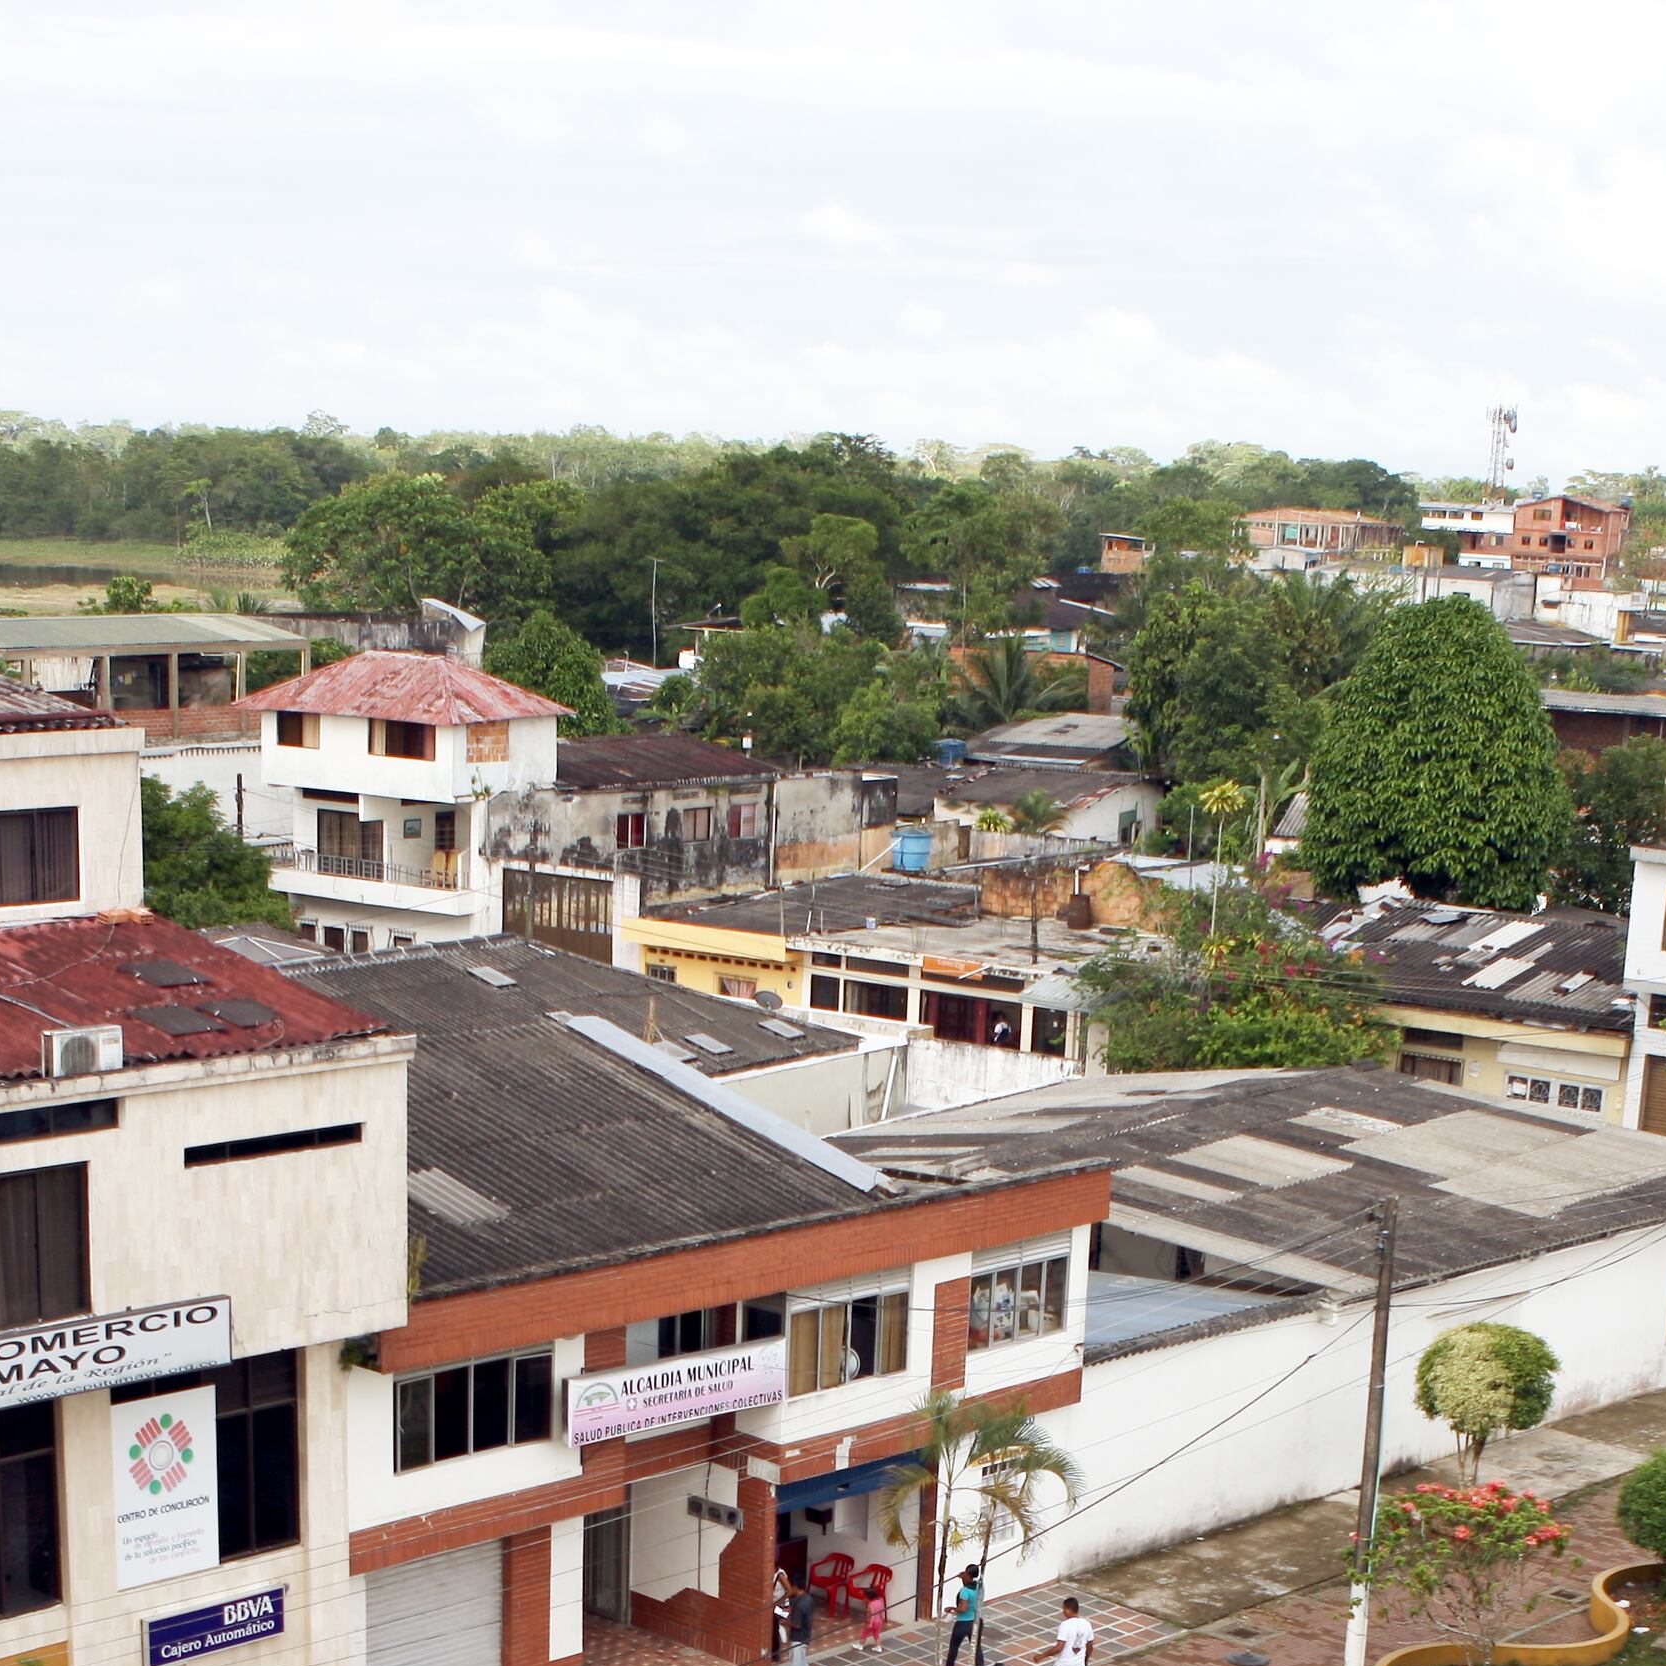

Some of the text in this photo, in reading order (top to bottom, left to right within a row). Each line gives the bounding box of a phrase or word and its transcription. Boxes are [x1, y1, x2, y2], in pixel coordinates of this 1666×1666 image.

[23, 1379, 49, 1392] de
[55, 1373, 76, 1384] la
[620, 1355, 755, 1397] ALCALDIA MUNICIPAL
[642, 1380, 734, 1409] SECRETARÍA DE SALUD
[574, 1389, 783, 1446] SALUD PUBLICA DE INTERVENCIONES COLECTIVAS
[117, 1510, 146, 1524] CENTRO
[148, 1507, 159, 1517] DE
[223, 1595, 274, 1626] BBVA
[161, 1619, 275, 1659] Cajero Automático
